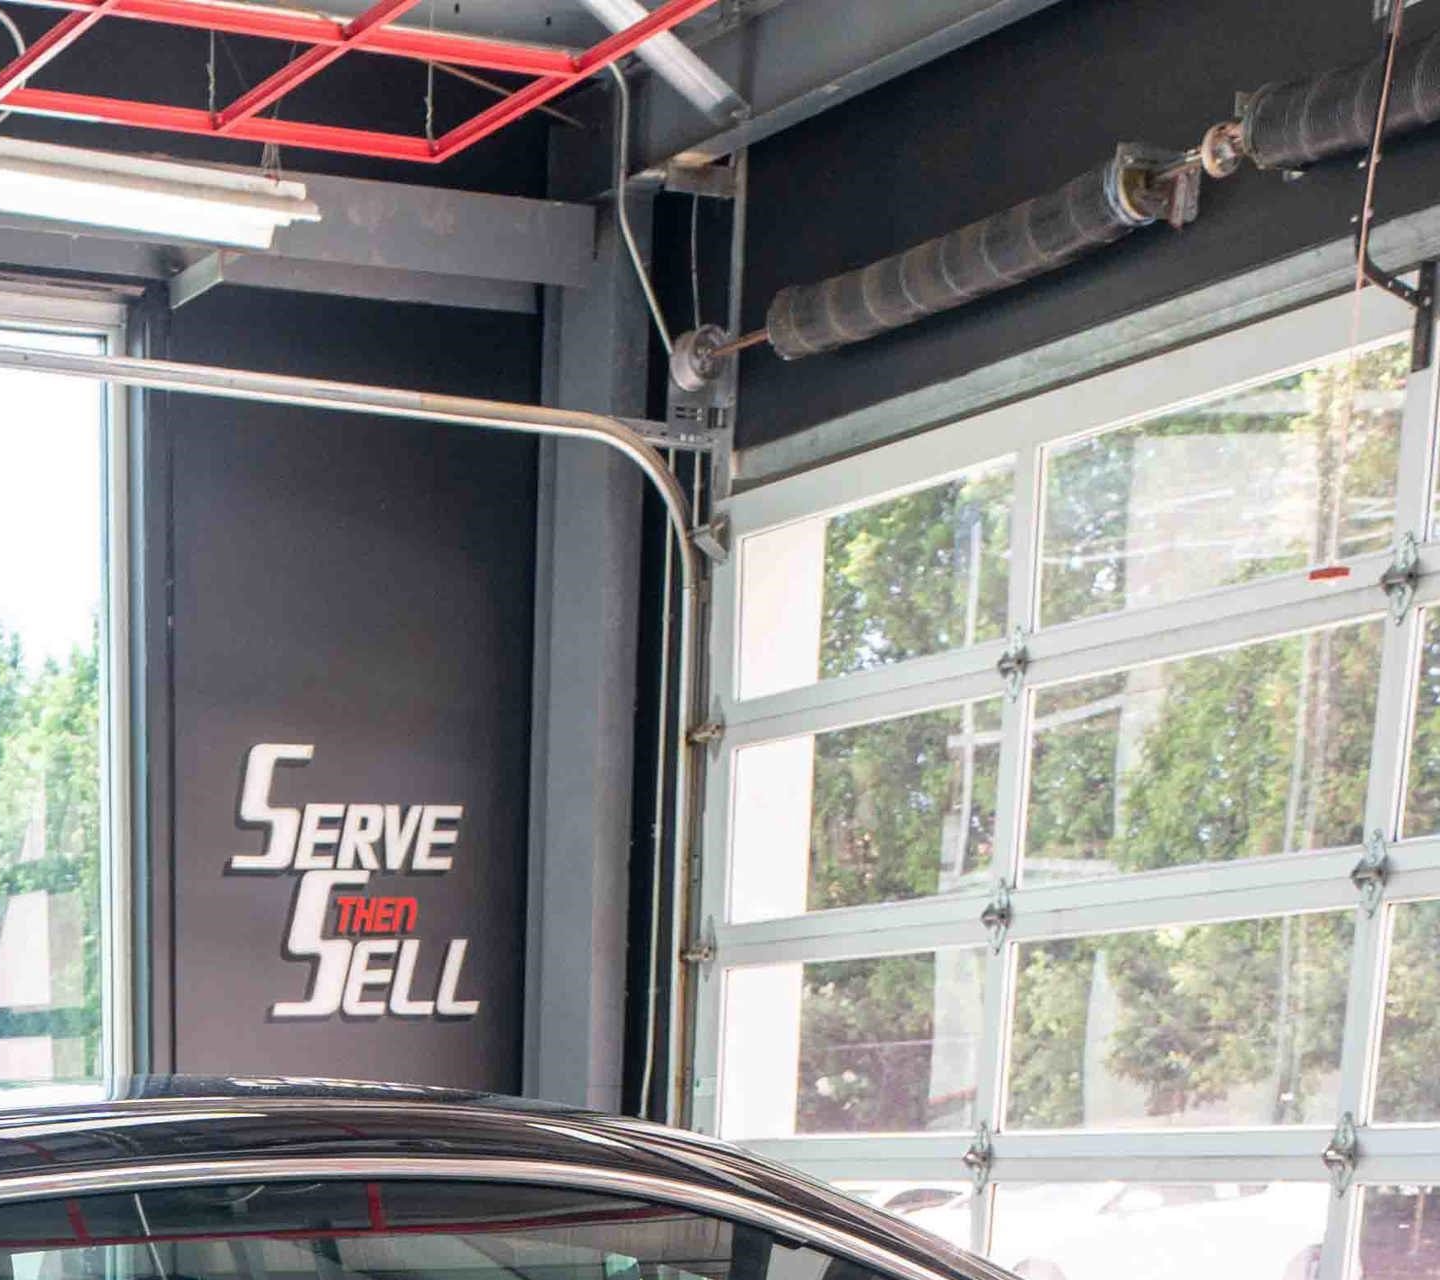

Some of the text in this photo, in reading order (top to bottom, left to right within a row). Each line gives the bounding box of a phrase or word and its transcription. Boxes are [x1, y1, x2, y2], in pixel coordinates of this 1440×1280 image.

[227, 742, 464, 872] SERVE
[270, 869, 480, 1017] SELL
[336, 896, 418, 933] THEN
